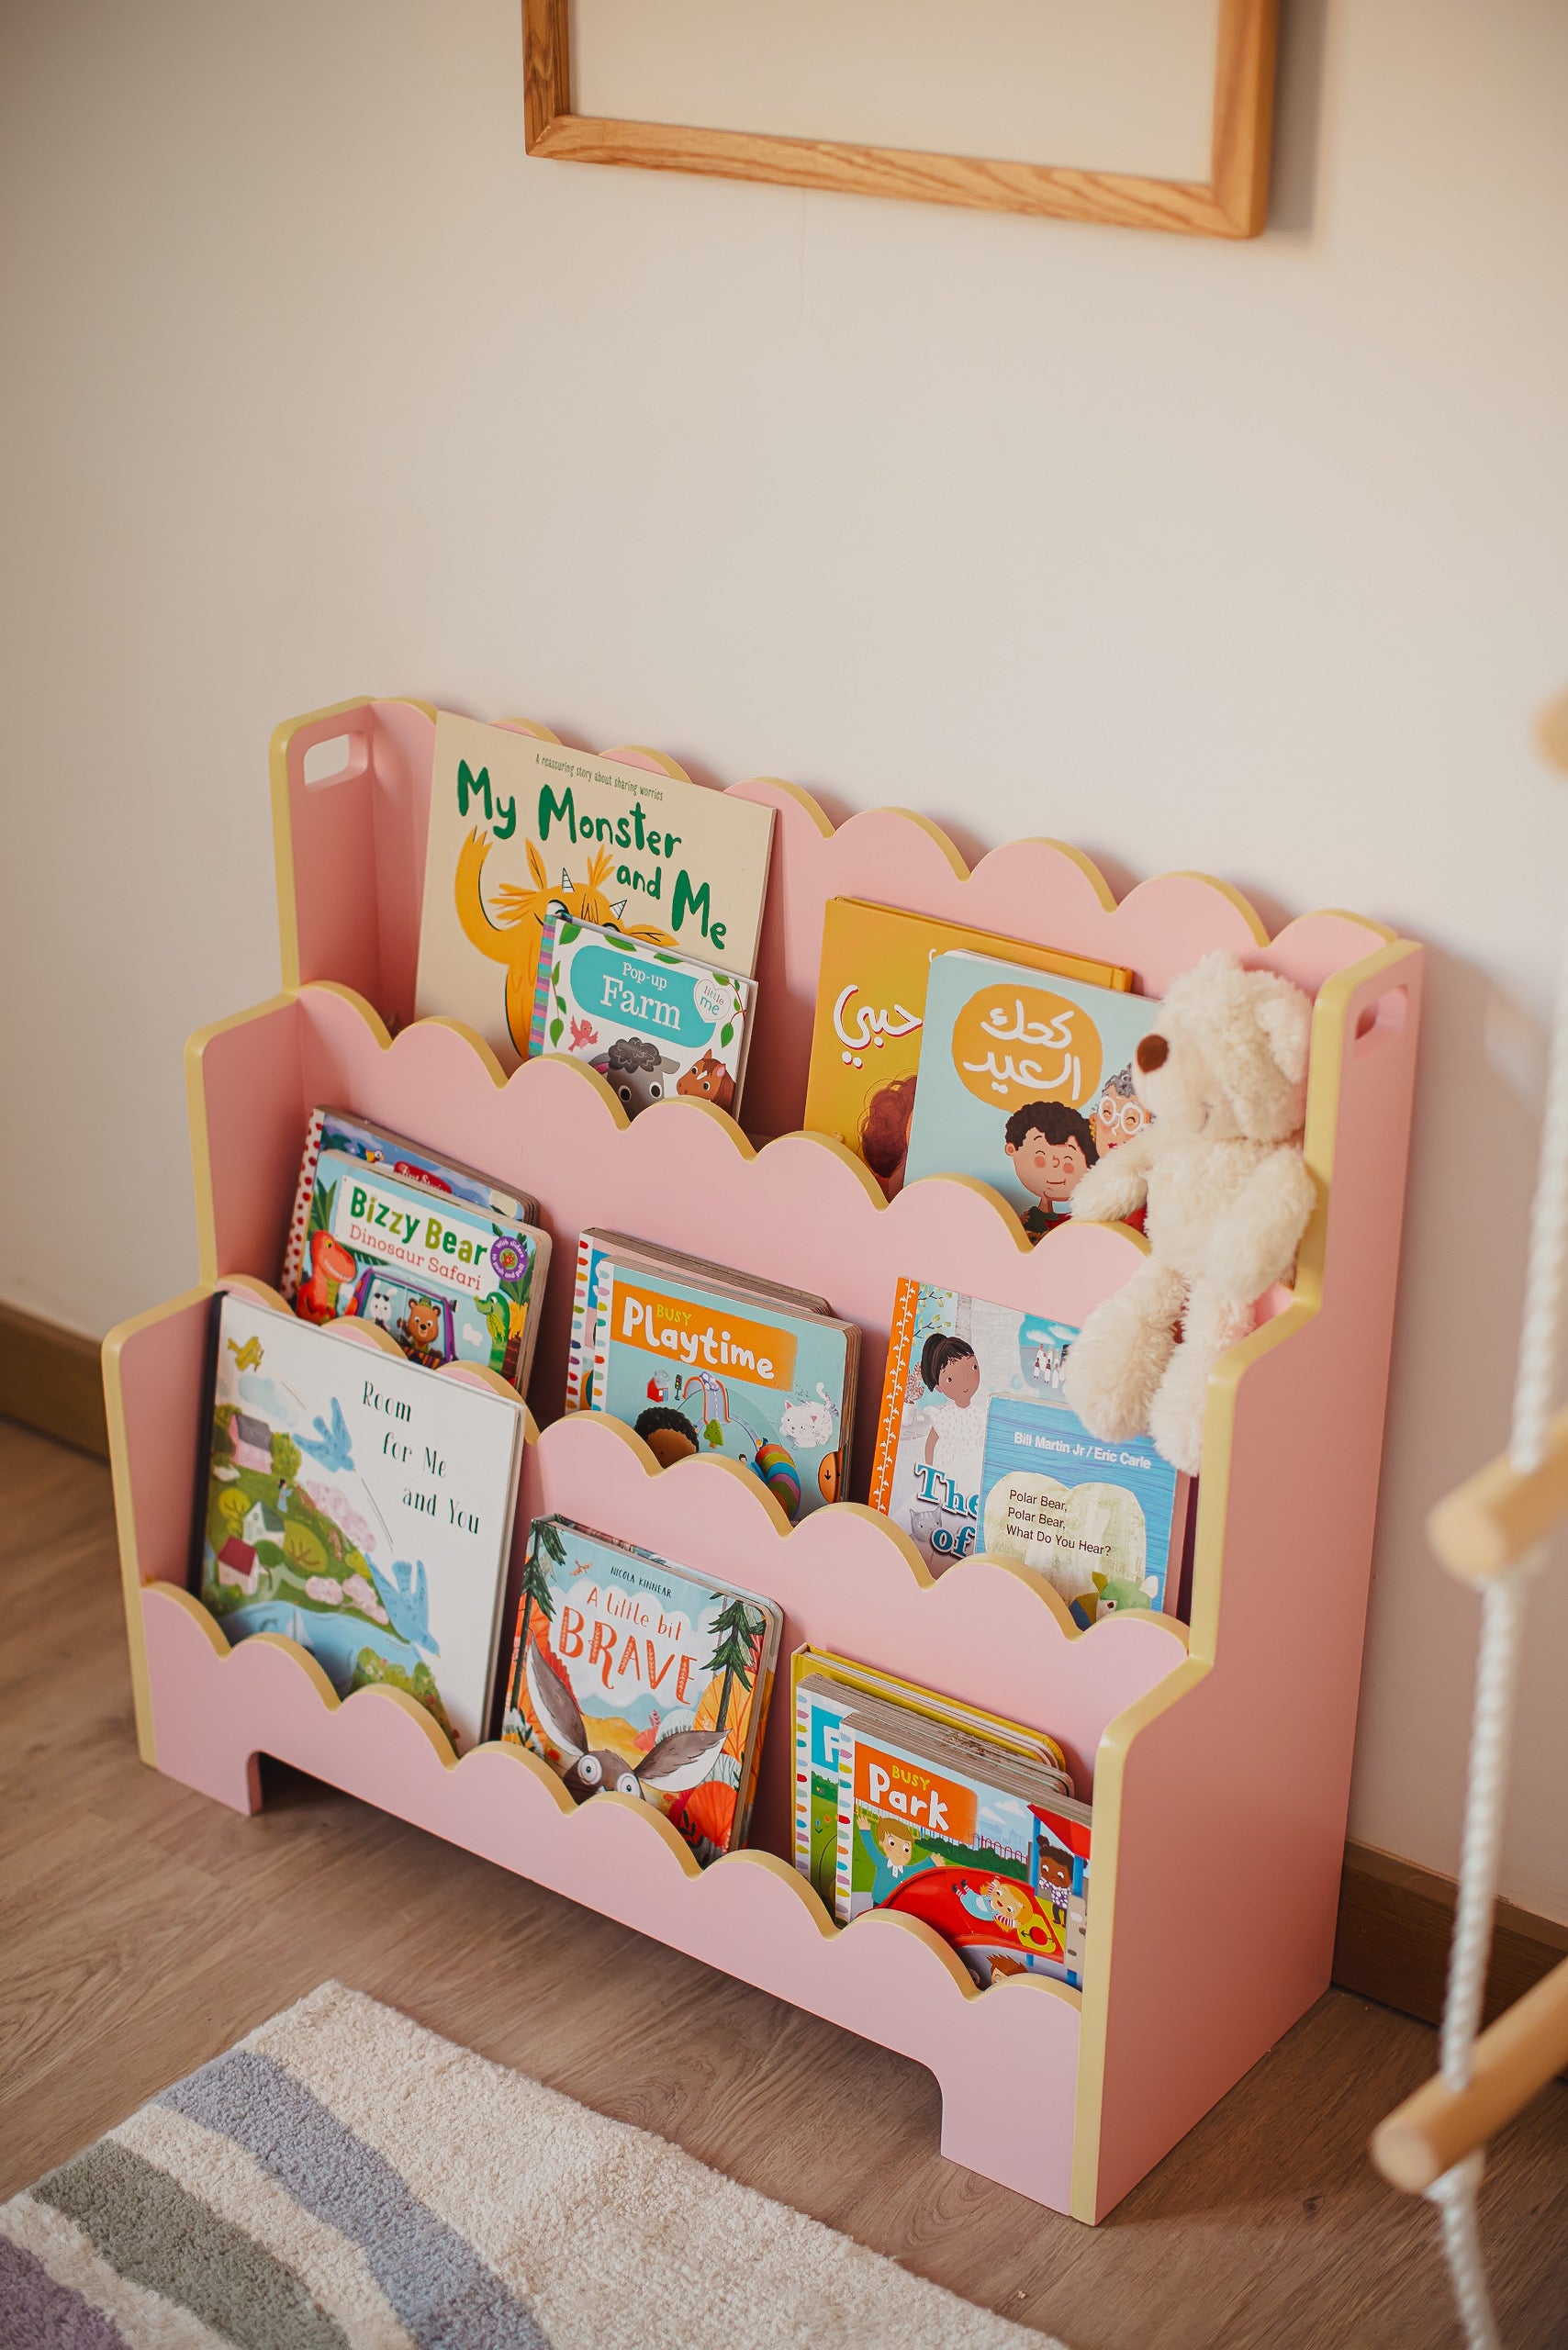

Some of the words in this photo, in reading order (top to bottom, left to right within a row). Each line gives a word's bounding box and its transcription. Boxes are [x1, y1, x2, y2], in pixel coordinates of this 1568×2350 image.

[535, 753, 540, 764] A
[542, 756, 574, 778] reassuring
[576, 766, 592, 782] story
[594, 771, 611, 786] about
[614, 778, 637, 796] sharing
[639, 785, 663, 801] worries
[457, 759, 516, 840] My
[538, 784, 682, 859] Monster
[616, 865, 662, 901] and
[671, 869, 727, 950] Me
[622, 961, 668, 990] Pop-up
[703, 985, 724, 1007] little
[599, 974, 681, 1031] Farm
[700, 995, 720, 1016] me
[980, 999, 1075, 1049] كحك
[963, 1051, 1081, 1102] العيد
[350, 1186, 421, 1245] Bizzy
[424, 1217, 488, 1267] Bear
[349, 1223, 425, 1268] Dinosaur
[427, 1256, 482, 1292] Safari
[622, 1296, 775, 1380] Playtime
[656, 1304, 692, 1326] BUSY
[363, 1381, 411, 1423] Room
[383, 1431, 412, 1462] for
[423, 1447, 446, 1478] Me
[1014, 1431, 1032, 1447] Bill
[1035, 1436, 1070, 1454] Martin
[1072, 1443, 1086, 1457] Jr
[1093, 1447, 1117, 1463] Eric
[1119, 1452, 1152, 1469] Carle
[402, 1488, 437, 1516] and
[450, 1498, 479, 1534] You
[1007, 1506, 1036, 1522] Polar
[1038, 1513, 1066, 1531] Bear,
[1010, 1489, 1037, 1505] Polar
[1040, 1495, 1068, 1514] Bear,
[932, 1527, 976, 1558] of
[1006, 1524, 1034, 1540] What
[1036, 1531, 1052, 1544] Do
[1056, 1535, 1075, 1549] You
[1079, 1540, 1112, 1557] Hear?
[610, 1566, 635, 1583] NICOLA
[638, 1577, 672, 1599] KINNEAR
[587, 1586, 598, 1607] A
[607, 1593, 649, 1628] little
[657, 1614, 681, 1640] bit
[559, 1606, 698, 1706] BRAVE
[868, 1762, 949, 1831] Park
[891, 1764, 930, 1791] BUSY
